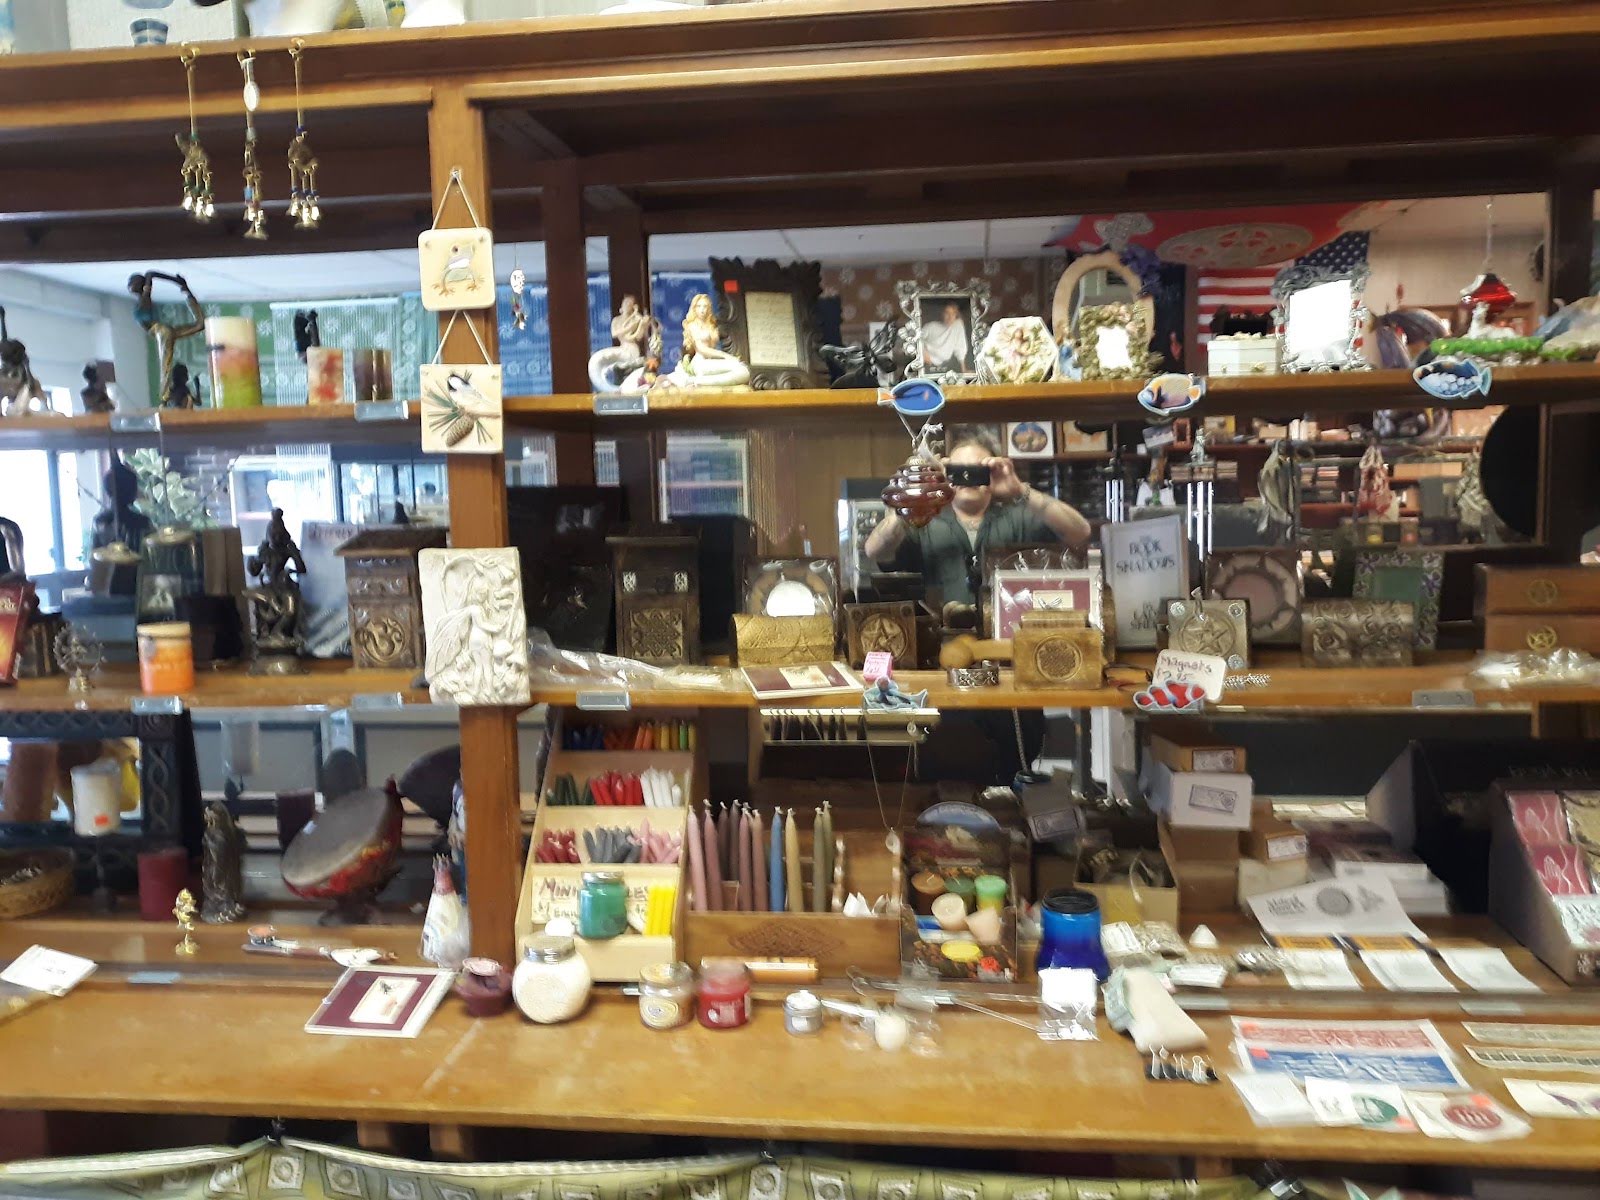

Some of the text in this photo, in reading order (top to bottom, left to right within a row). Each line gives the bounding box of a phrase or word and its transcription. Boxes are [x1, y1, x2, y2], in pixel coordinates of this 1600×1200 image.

[1129, 540, 1162, 555] BOOK
[1115, 556, 1175, 573] SHADOWS
[1160, 656, 1212, 673] Magnets
